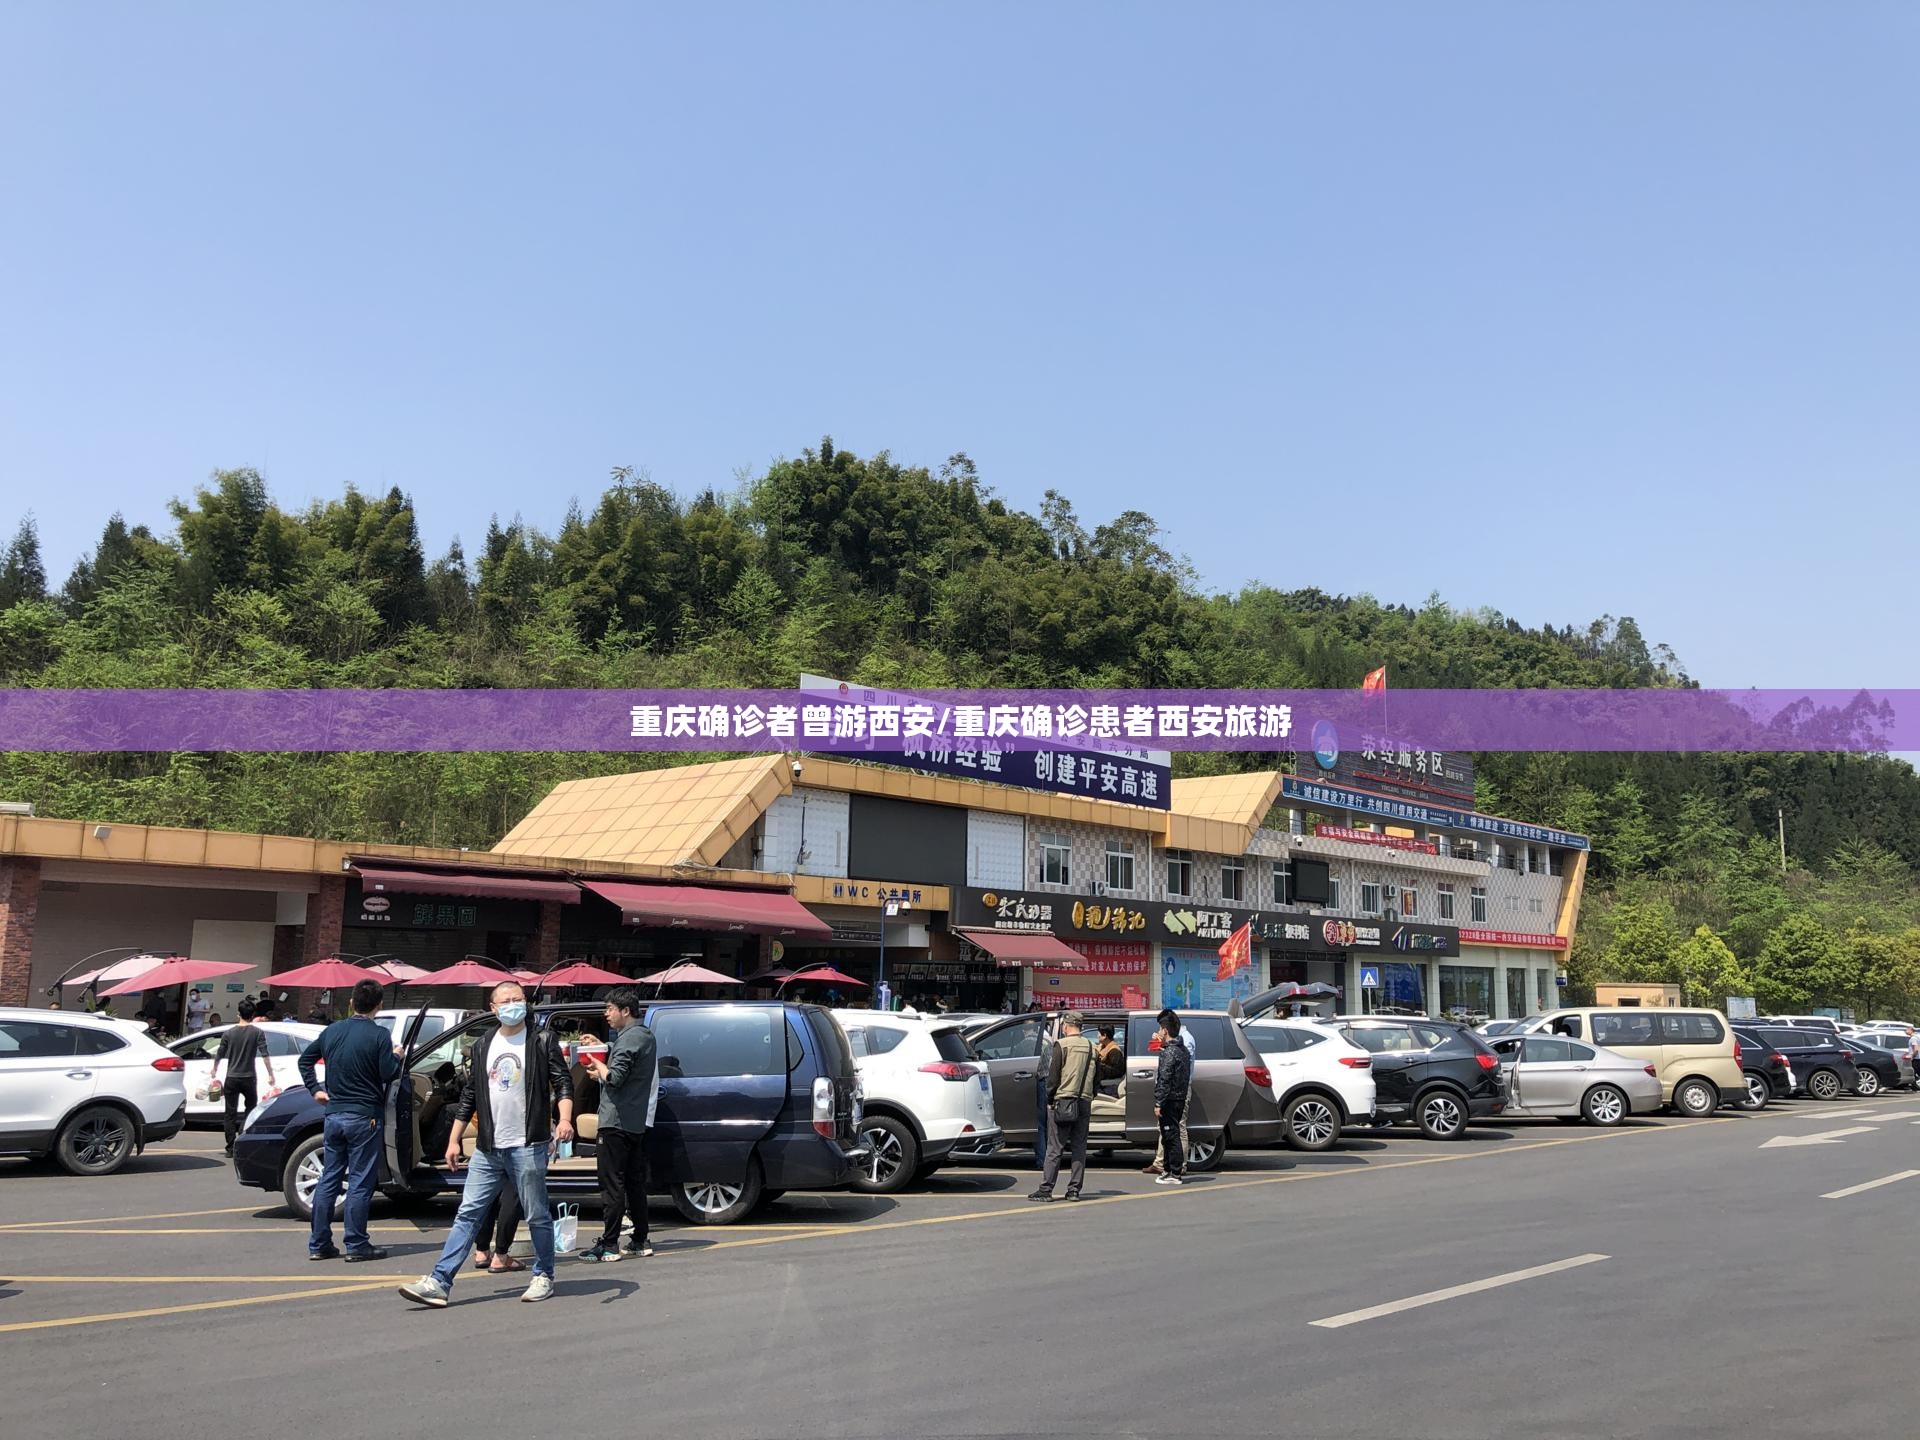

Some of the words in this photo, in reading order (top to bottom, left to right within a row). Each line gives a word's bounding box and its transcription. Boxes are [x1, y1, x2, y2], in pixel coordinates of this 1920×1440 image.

[1361, 733, 1444, 776] 荥经服务区
[1035, 749, 1159, 800] 创建平安高速
[1304, 785, 1363, 808] 诚信建设万里行
[1367, 798, 1428, 820] 共创四川信用交通
[848, 885, 869, 898] WC
